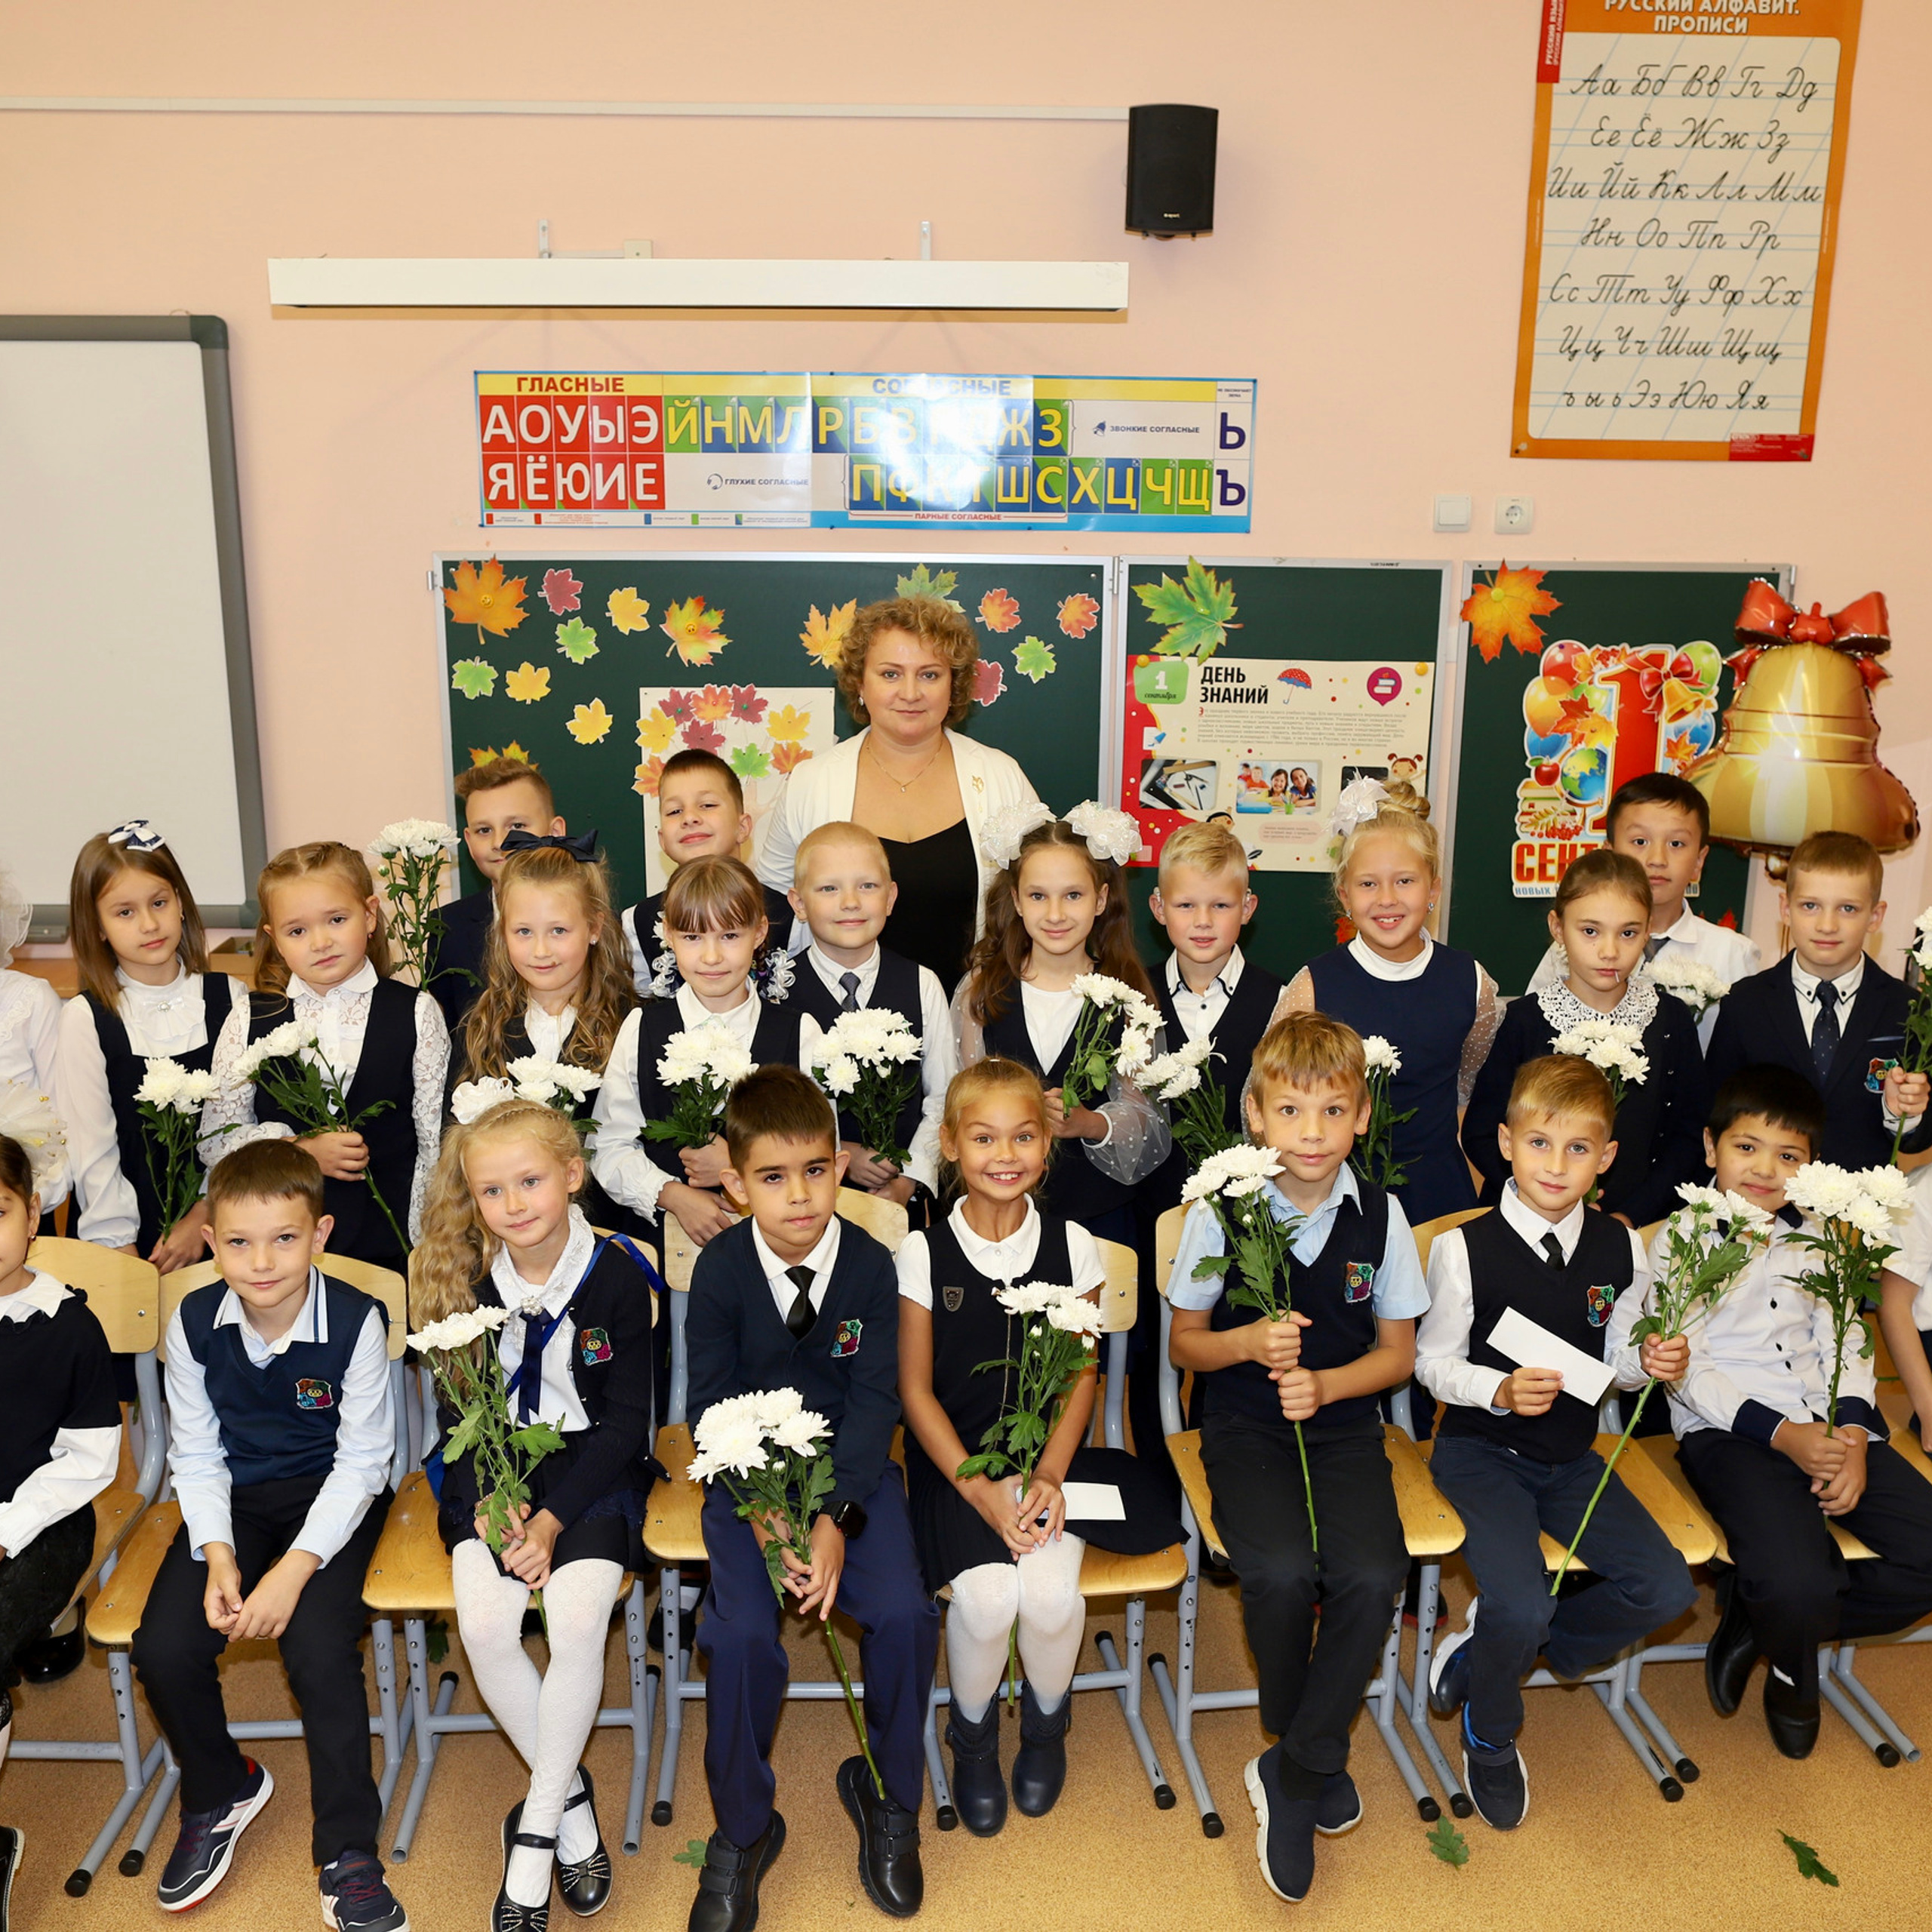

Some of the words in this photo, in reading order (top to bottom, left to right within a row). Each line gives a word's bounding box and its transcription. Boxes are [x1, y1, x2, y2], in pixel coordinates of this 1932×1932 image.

[1699, 0, 1800, 14] АЛФАВИТ.
[1654, 15, 1749, 33] ПРОПИСИ
[516, 377, 625, 393] ГЛАСНЫЕ
[872, 378, 1012, 396] СОАСНЫЕ
[1155, 670, 1168, 690] 1
[1201, 666, 1246, 685] ДЕНЬ
[1200, 685, 1269, 704] ЗНАНИЙ
[1515, 887, 1551, 896] НОВЫХ
